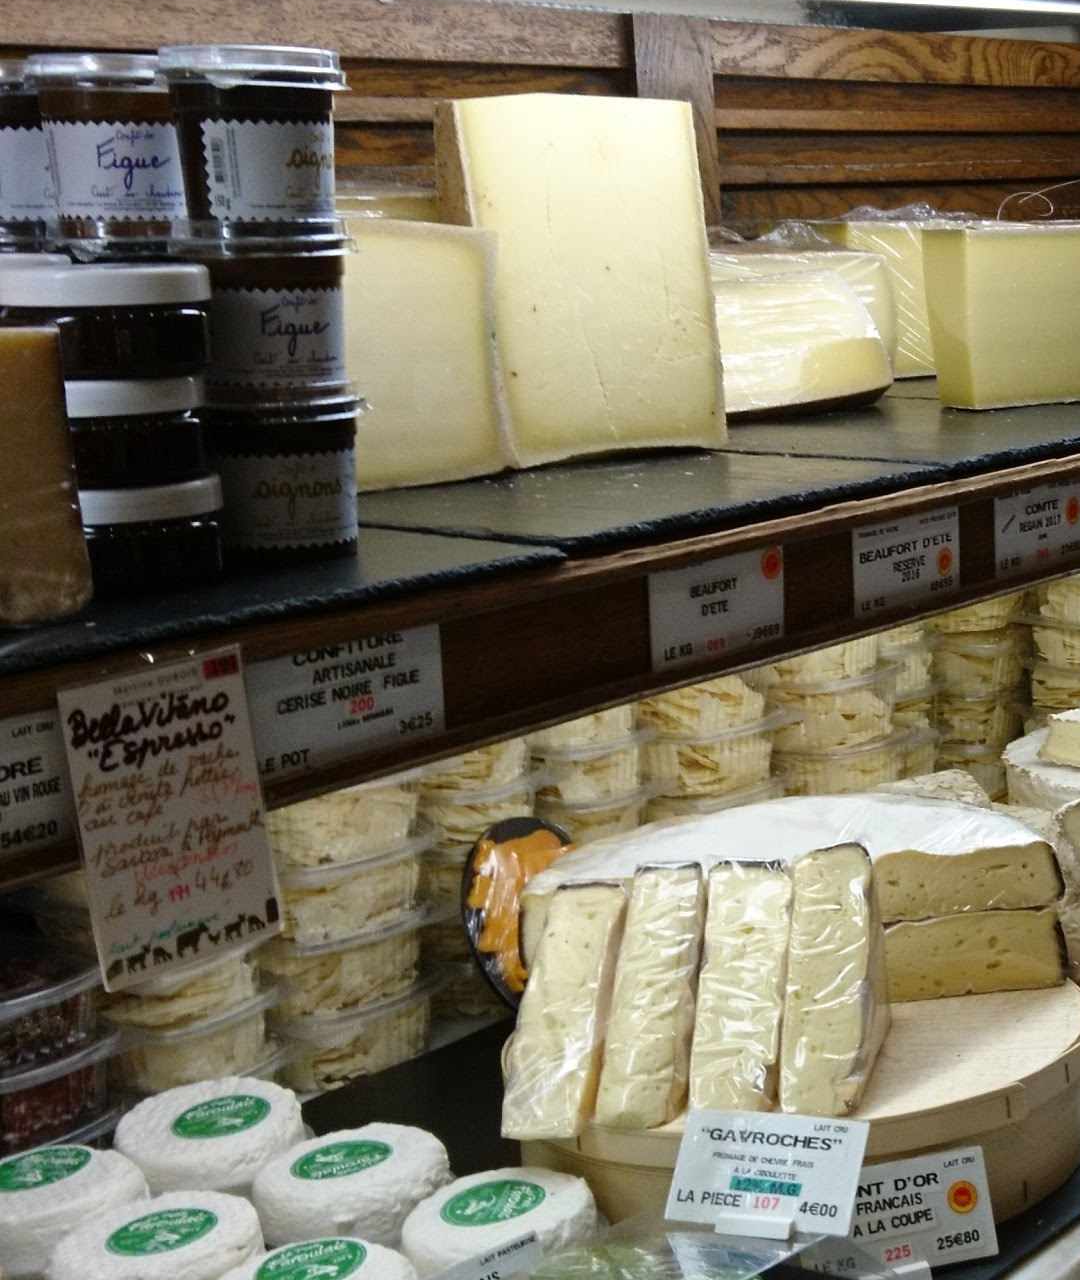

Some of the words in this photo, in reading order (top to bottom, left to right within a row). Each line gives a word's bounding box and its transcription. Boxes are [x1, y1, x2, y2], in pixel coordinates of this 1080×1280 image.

[96, 137, 171, 190] Figue
[259, 304, 331, 356] Figue
[252, 477, 343, 522] oignons
[1025, 499, 1060, 516] COMTE
[1019, 518, 1044, 534] REGAIN
[1045, 514, 1062, 530] 2017
[859, 539, 919, 565] BEAUFORT
[922, 532, 953, 550] D'ETE
[892, 555, 926, 574] RESERVE
[901, 568, 921, 584] 2016
[689, 577, 738, 600] BEAUFORT
[701, 600, 729, 618] D'ETE
[292, 631, 403, 667] CONFITURE
[663, 645, 678, 662] LE
[679, 642, 694, 659] KG
[312, 652, 397, 685] ARTISANALE
[277, 690, 327, 715] CERISE
[332, 679, 373, 702] NOIRE
[383, 669, 421, 690] FIGUE
[349, 696, 375, 714] 200
[12, 723, 33, 739] LAIT
[36, 720, 53, 734] CRU
[400, 712, 433, 734] 3€25
[281, 748, 311, 768] POT
[13, 784, 31, 804] VIN
[32, 776, 62, 799] ROUGE
[0, 820, 58, 849] 54€20
[814, 1123, 833, 1133] LAIT
[834, 1125, 849, 1134] CRU
[712, 1151, 747, 1163] FROMAGE
[792, 1159, 815, 1169] FRAIS
[943, 1158, 961, 1169] LAIT
[962, 1155, 976, 1166] CRU
[754, 1169, 798, 1181] CIBOULETTE
[857, 1180, 885, 1199] NT
[894, 1172, 940, 1193] D'OR
[676, 1188, 695, 1205] LA
[700, 1190, 742, 1209] PIECE
[752, 1196, 782, 1211] 107
[799, 1201, 838, 1218] 4€00
[856, 1191, 924, 1216] FRANCAIS
[853, 1223, 863, 1239] A
[868, 1218, 887, 1236] LA
[891, 1208, 934, 1230] COUPE
[479, 1253, 497, 1267] LAIT
[497, 1234, 537, 1259] PASTEURISE
[885, 1243, 912, 1263] 225
[936, 1228, 981, 1251] 25€80
